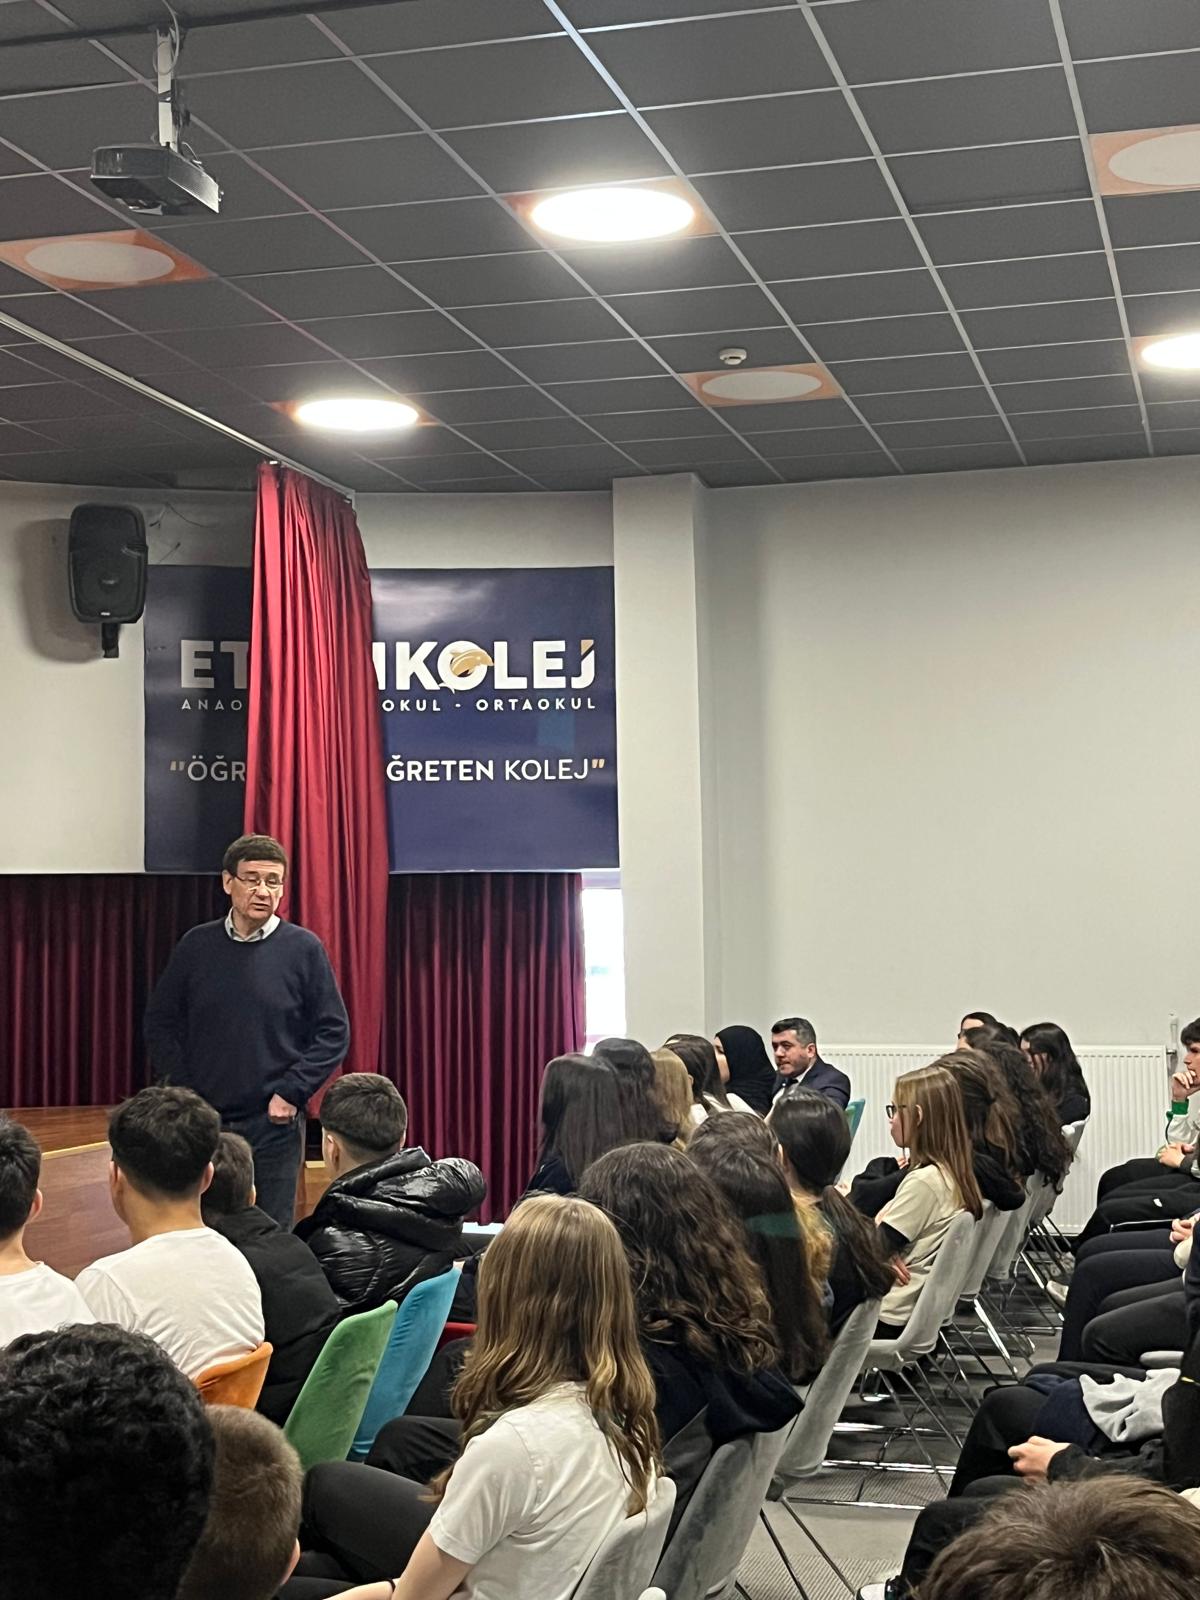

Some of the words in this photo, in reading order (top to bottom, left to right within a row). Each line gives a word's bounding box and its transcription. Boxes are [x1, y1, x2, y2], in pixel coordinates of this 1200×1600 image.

[180, 639, 249, 690] ET
[371, 639, 596, 694] KOLEJ
[181, 699, 243, 710] ANAO
[382, 699, 441, 712] OKUL
[476, 697, 596, 712] ORTAOKUL
[170, 754, 246, 782] "ÖĞR
[386, 754, 494, 782] ĞRETEN
[505, 758, 605, 781] KOLEJ"
